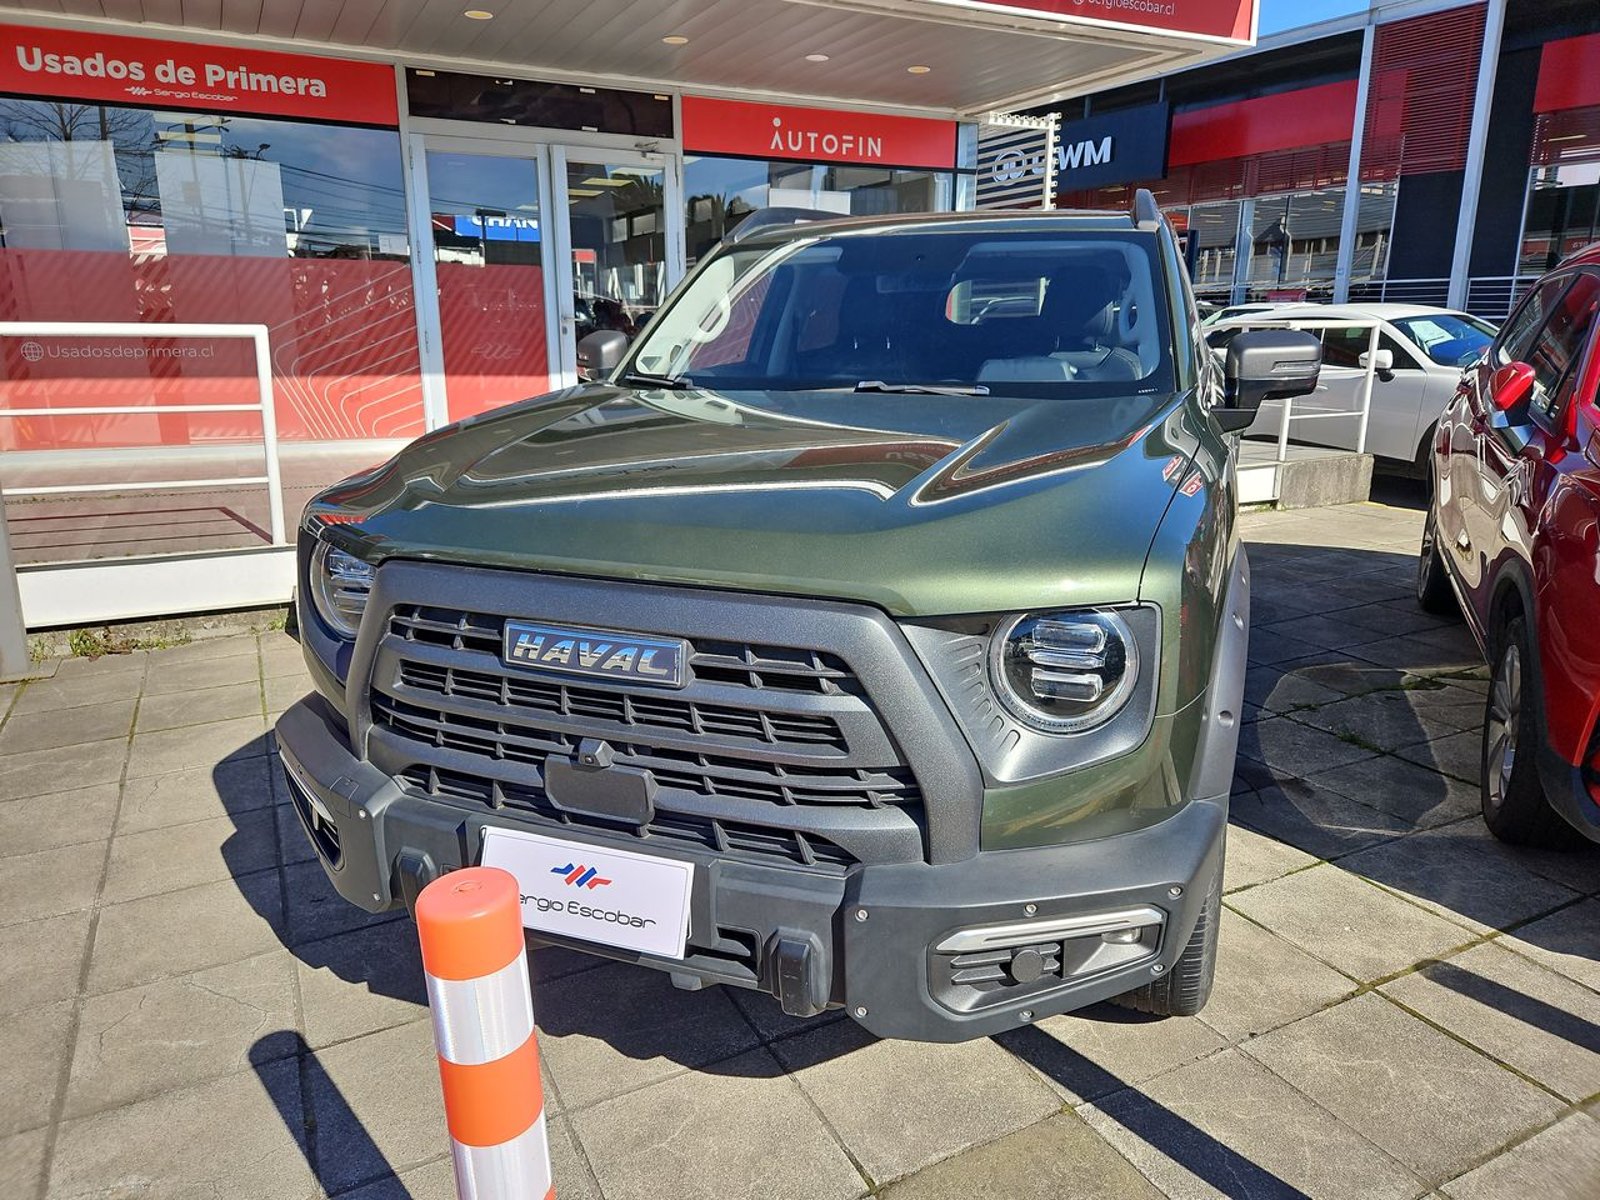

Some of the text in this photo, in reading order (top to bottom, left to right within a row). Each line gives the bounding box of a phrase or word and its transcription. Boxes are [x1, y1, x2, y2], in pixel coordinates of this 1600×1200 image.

[15, 45, 327, 98] Usados de Primera
[770, 117, 882, 158] AUTOFIN
[47, 345, 215, 359] Usadosdeprimera.cl
[513, 633, 668, 676] HAVAL
[519, 893, 656, 928] ergio Escobar
